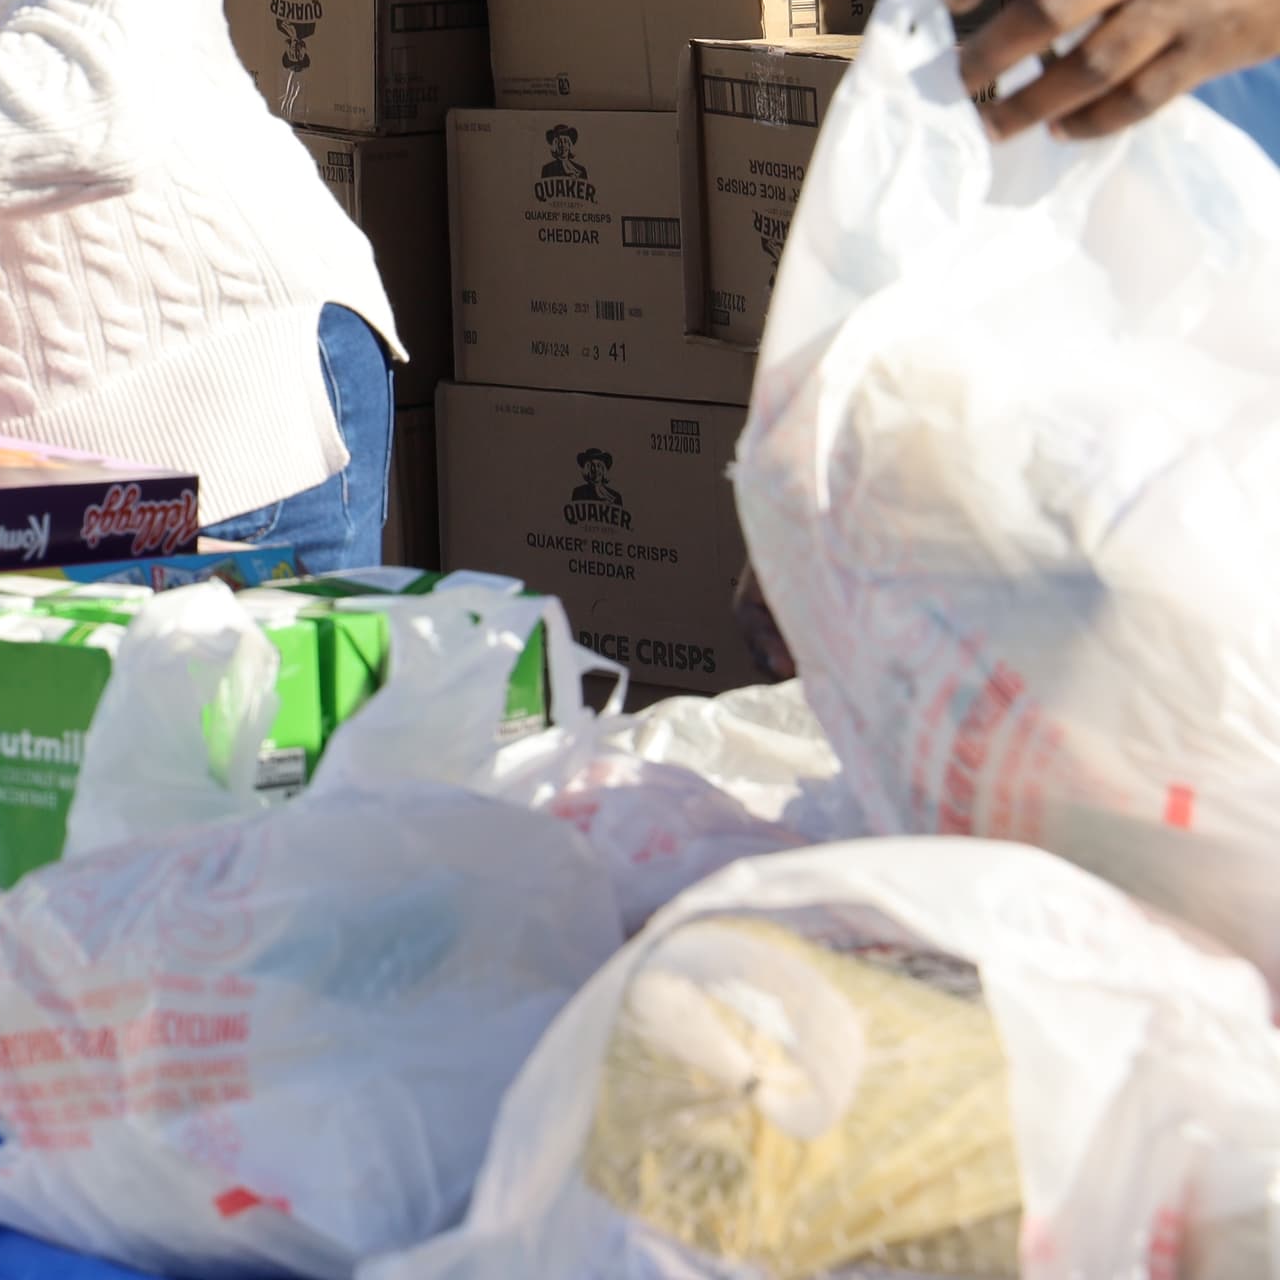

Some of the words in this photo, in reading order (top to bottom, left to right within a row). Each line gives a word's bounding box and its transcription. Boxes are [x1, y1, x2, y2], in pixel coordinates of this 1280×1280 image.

[748, 159, 804, 181] CHEDDAR
[534, 179, 597, 203] QUAKER
[716, 176, 757, 198] CRISPS
[760, 183, 786, 201] RICE
[562, 212, 580, 222] RICE
[582, 213, 611, 223] CRISPS
[753, 211, 791, 237] AKER
[538, 228, 600, 245] CHEDDAR
[593, 345, 600, 361] 3
[608, 342, 627, 363] 41
[650, 433, 701, 455] 32122/003
[81, 483, 199, 555] Kellogg's
[563, 503, 633, 531] QUAKER
[591, 539, 623, 557] RICE
[627, 543, 678, 564] CRISPS
[568, 559, 635, 580] CHEDDAR
[636, 638, 716, 673] CRISPS
